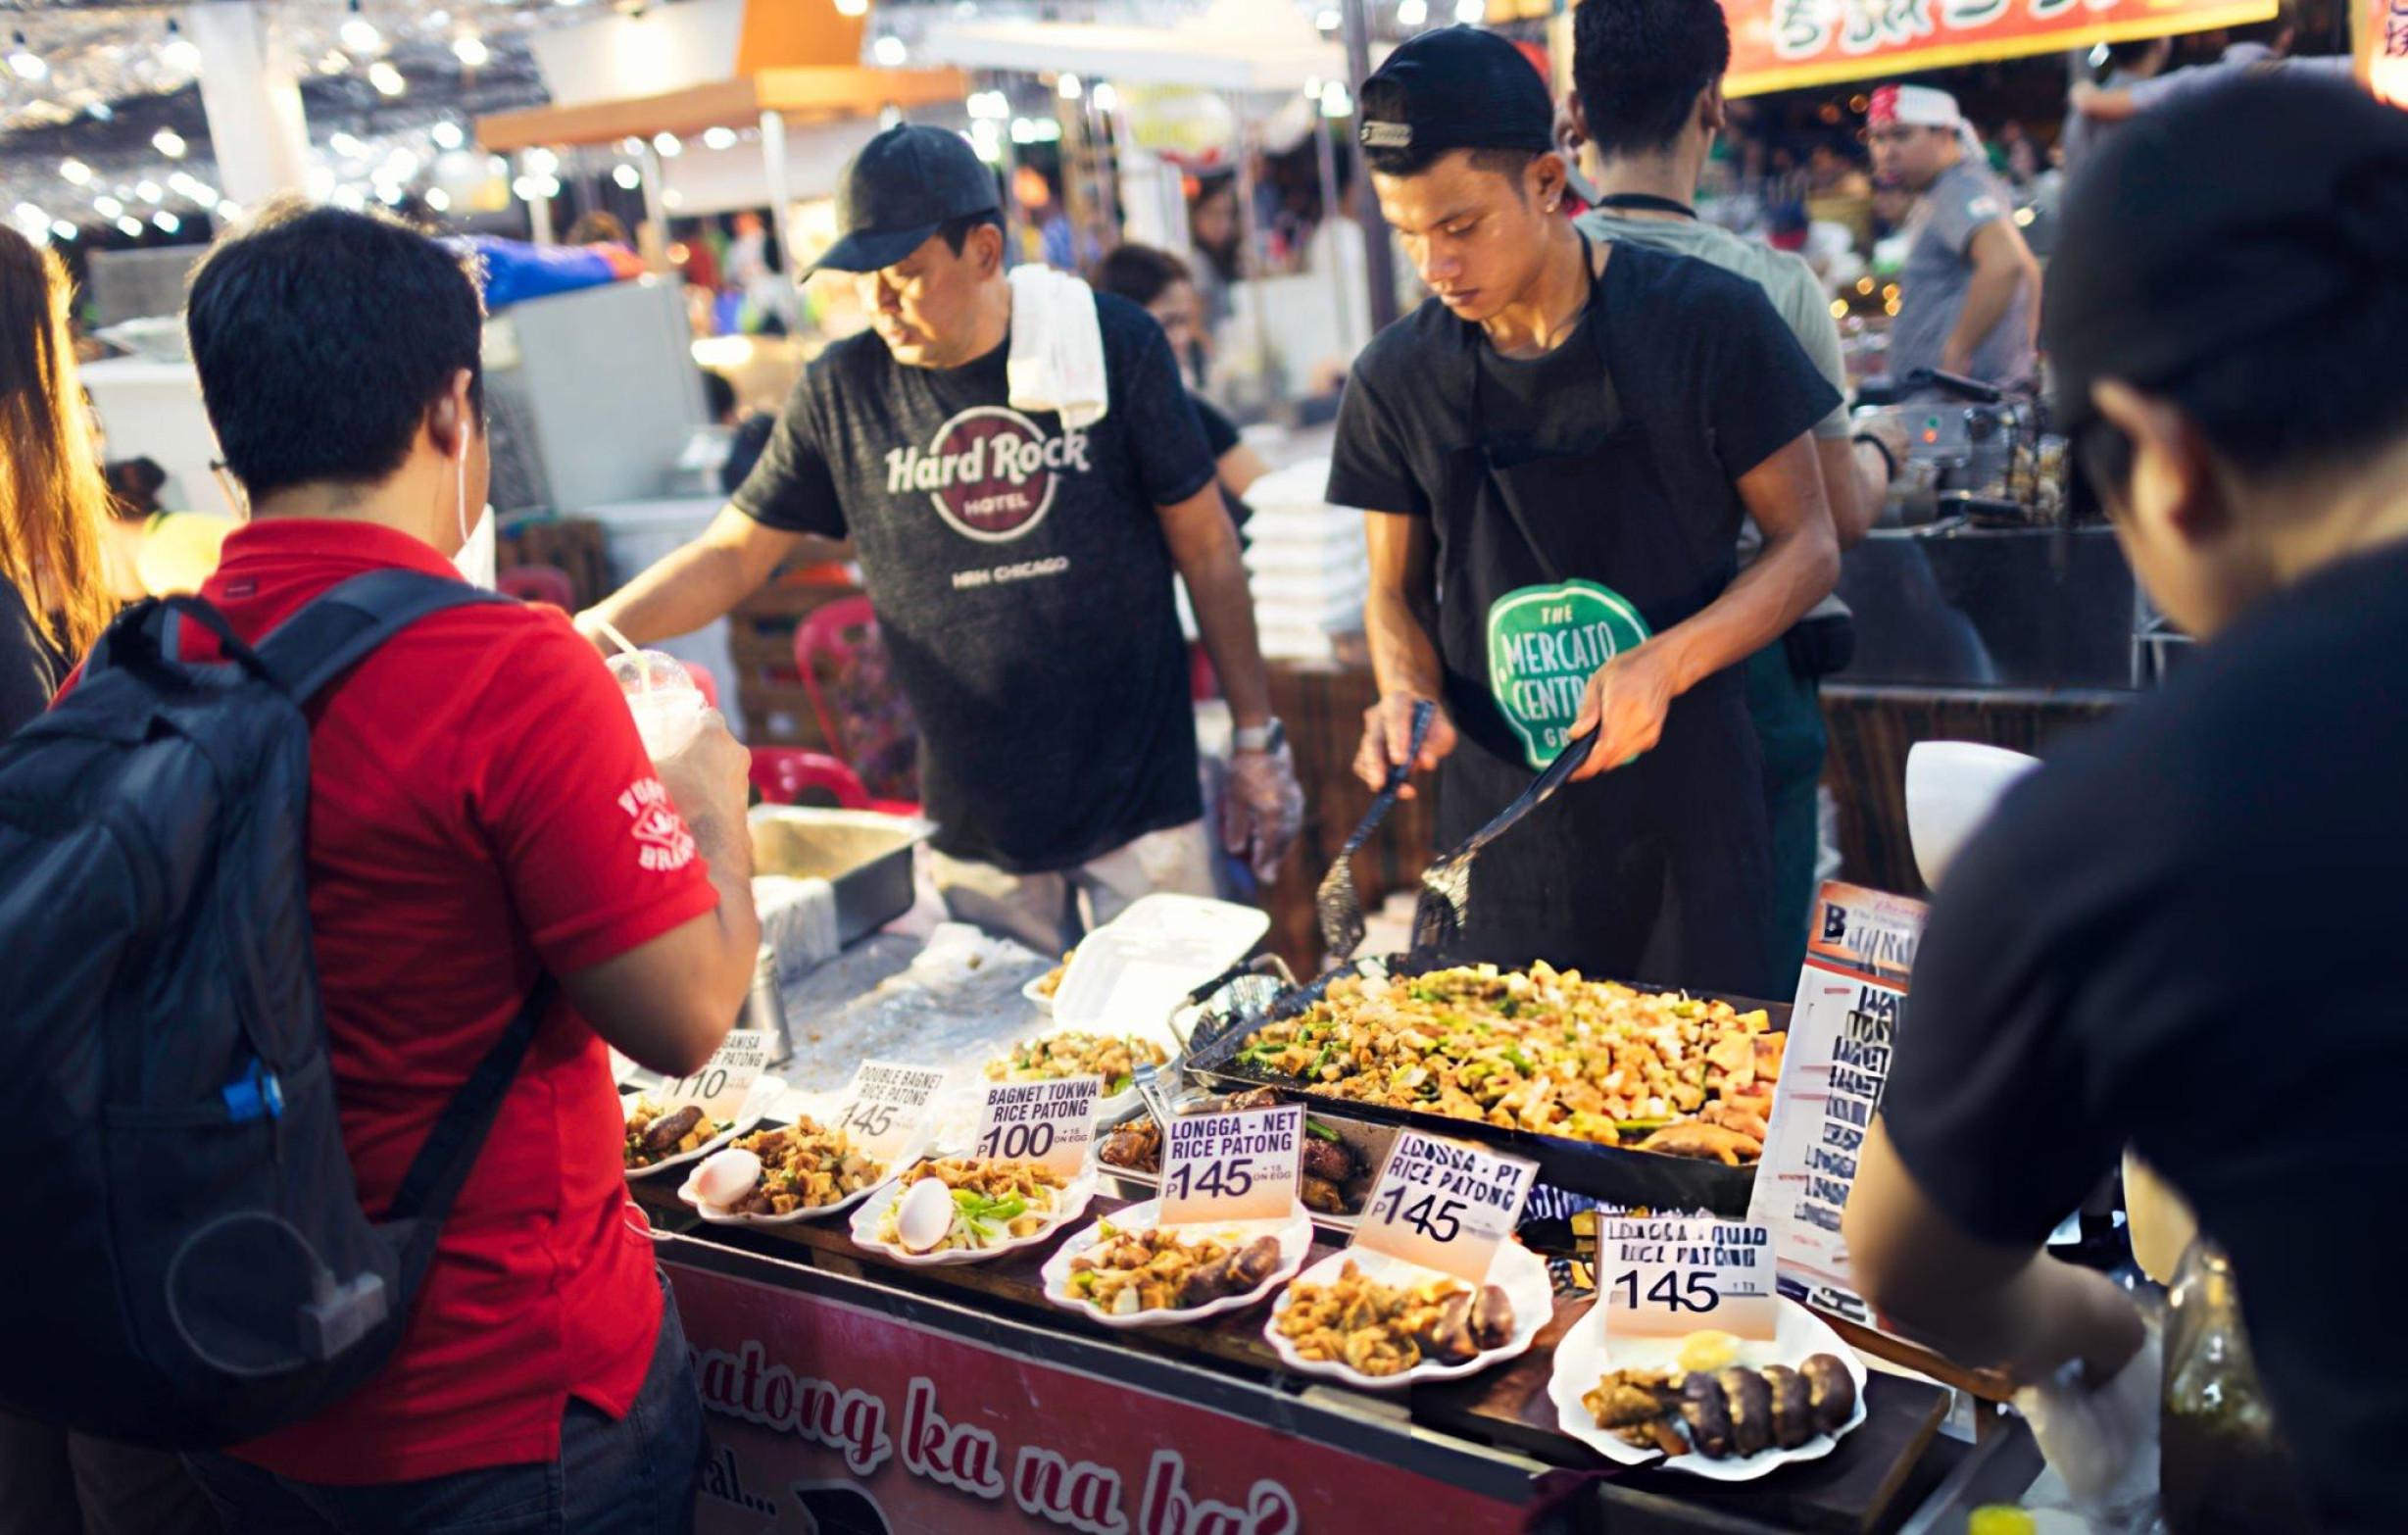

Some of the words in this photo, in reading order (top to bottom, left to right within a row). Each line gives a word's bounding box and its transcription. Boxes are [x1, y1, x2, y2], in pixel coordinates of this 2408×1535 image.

[885, 434, 984, 493] Hard
[990, 428, 1092, 484] Rock
[964, 493, 1029, 516] HOTEL
[994, 556, 1069, 582] CHICAGO
[1541, 604, 1573, 624] THE
[1501, 621, 1616, 676] MERCATO
[722, 1052, 763, 1067] PATONG
[987, 1085, 1045, 1106] BAGNET
[1048, 1079, 1098, 1100] TOKWA
[840, 1102, 899, 1136] 145
[993, 1105, 1028, 1123] RICE
[1031, 1099, 1089, 1119] PATONG
[1171, 1116, 1242, 1140] LONGGA
[1263, 1112, 1298, 1132] NET
[1172, 1139, 1214, 1160] RICE
[1221, 1132, 1292, 1156] PATONG
[1615, 1269, 1719, 1312] 145
[689, 1348, 886, 1465] atong
[907, 1386, 999, 1488] ka
[1019, 1456, 1123, 1530] na
